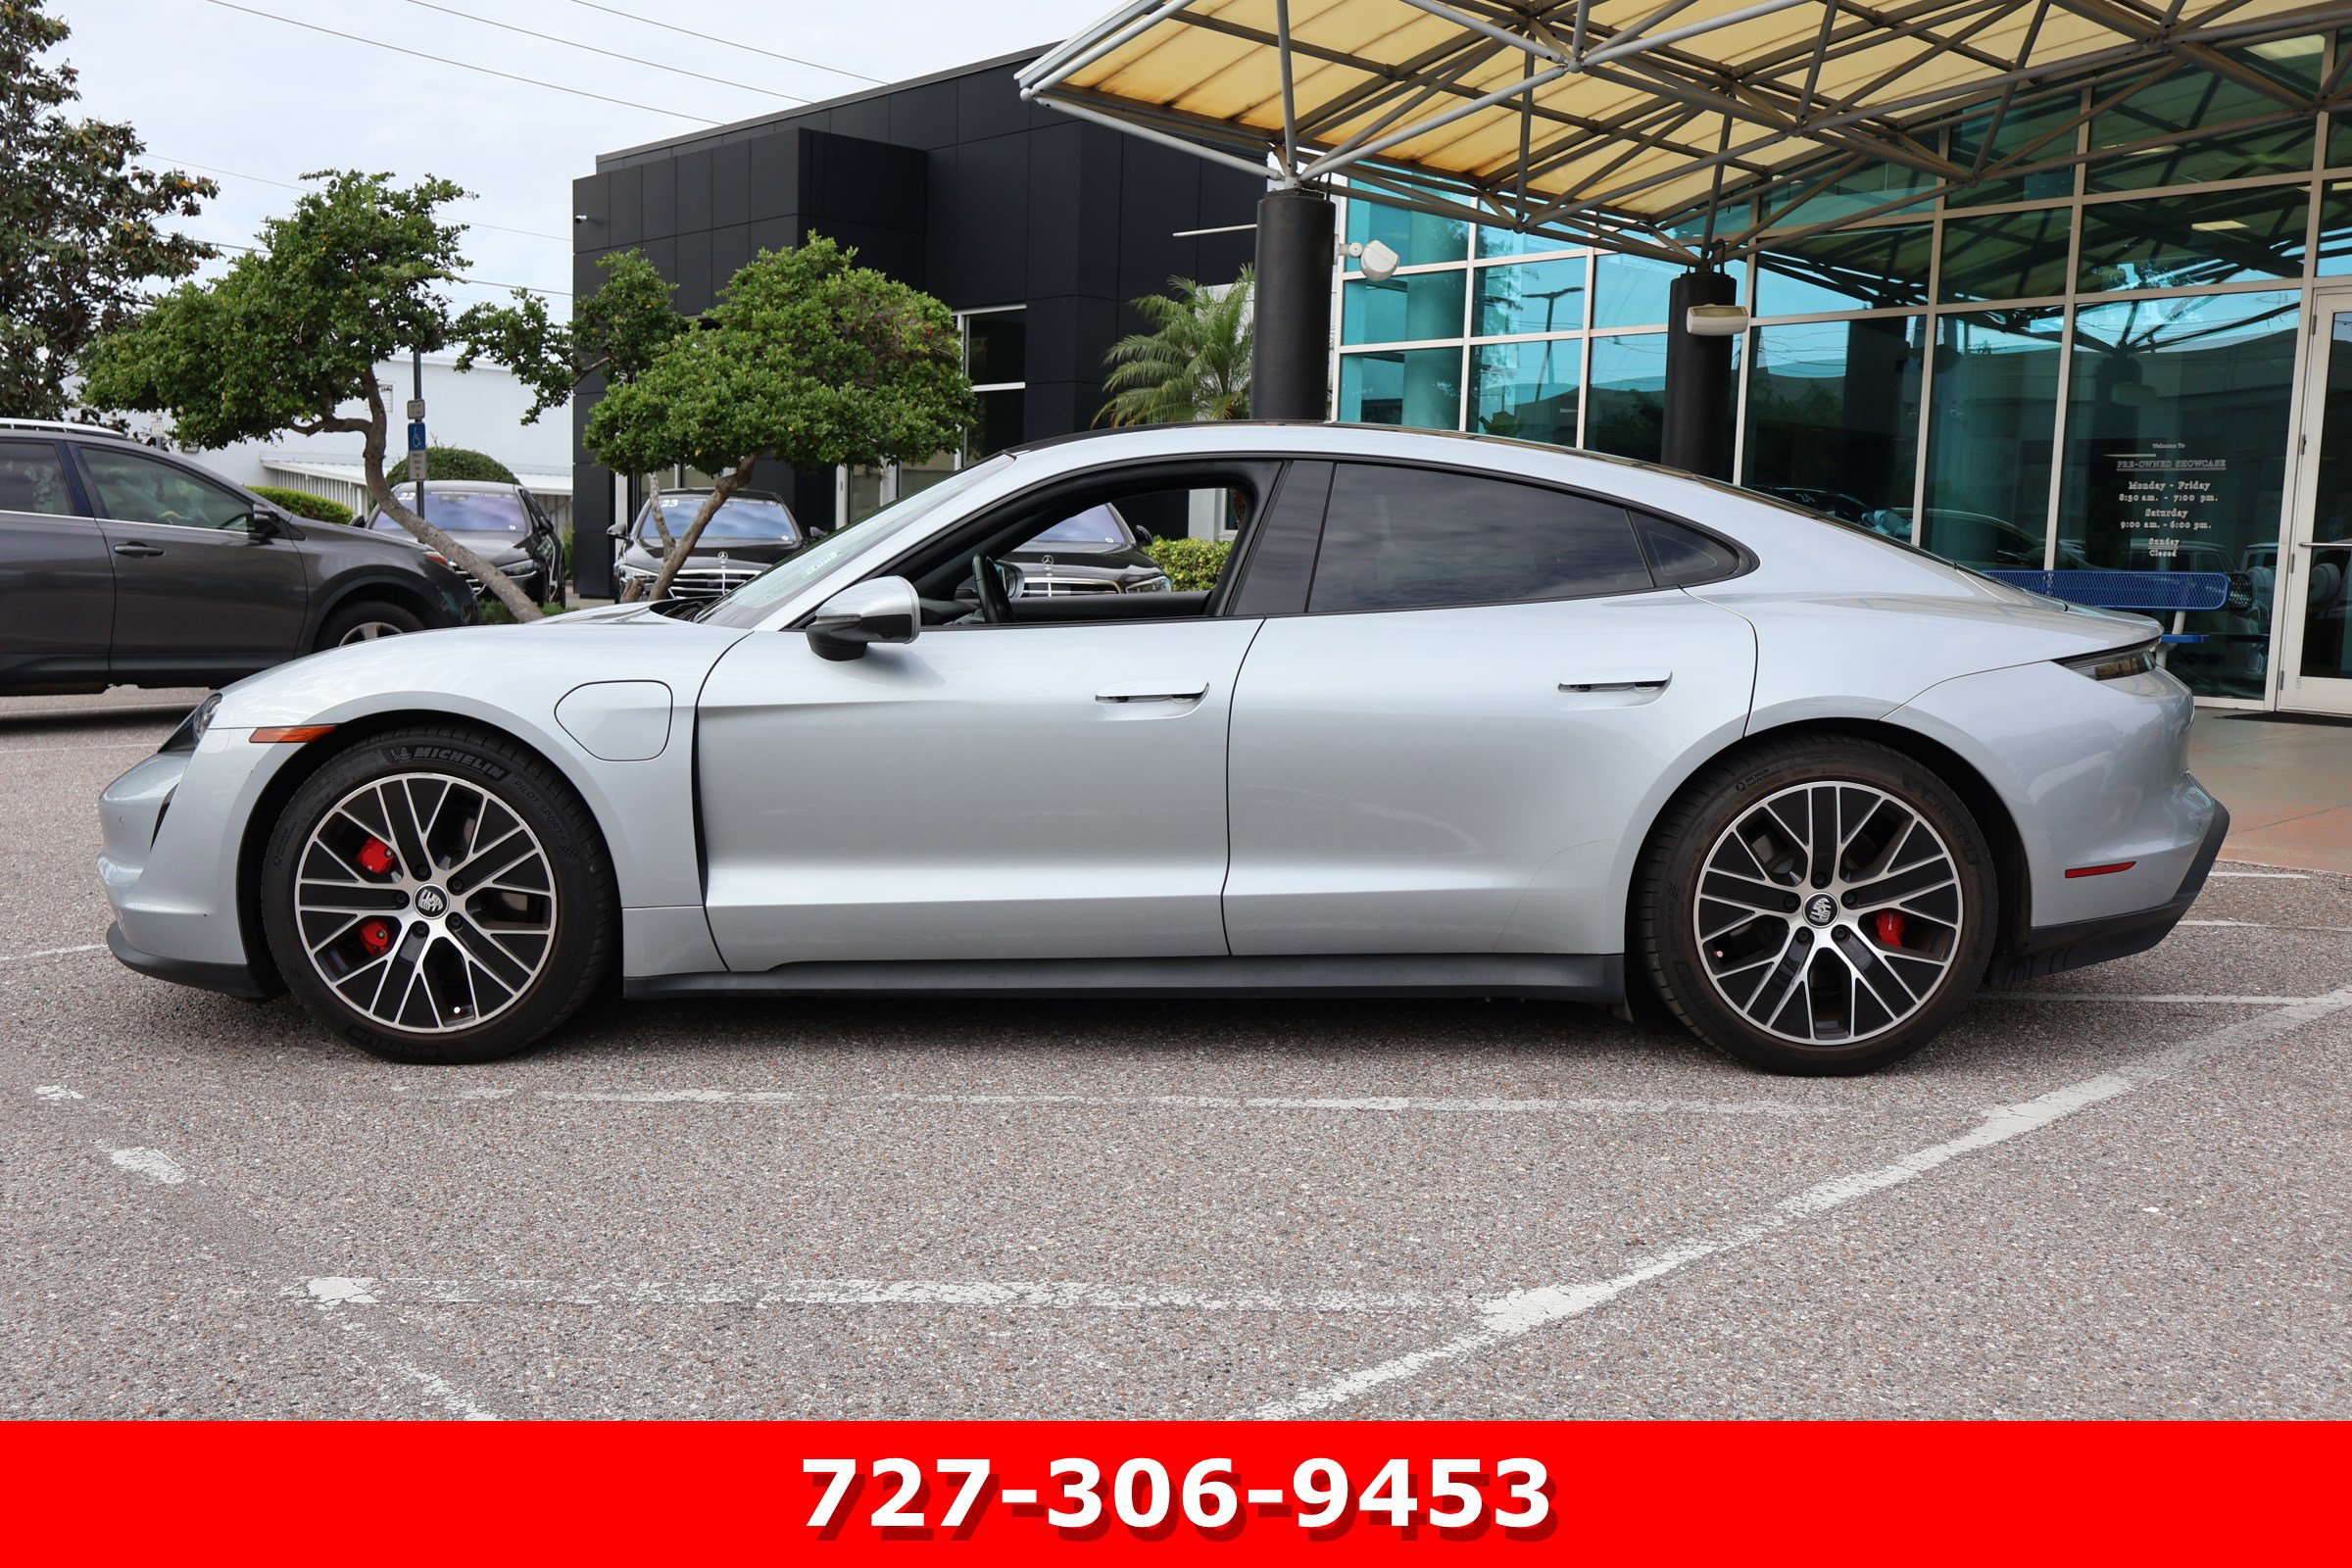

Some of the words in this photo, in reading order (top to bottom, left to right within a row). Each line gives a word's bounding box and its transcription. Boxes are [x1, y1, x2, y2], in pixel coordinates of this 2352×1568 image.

[2117, 460, 2172, 468] PRE-OWNED
[2175, 459, 2226, 467] SHOWCASE
[2129, 480, 2166, 491] Monday
[2178, 480, 2210, 491] Friday
[2119, 493, 2139, 502] 8:30
[2199, 494, 2218, 503] pm.
[2144, 508, 2188, 518] Saturday
[2148, 537, 2180, 547] Sunday
[414, 747, 506, 779] MICHELIN
[513, 780, 540, 803] PILOT
[537, 804, 563, 833] SPORT
